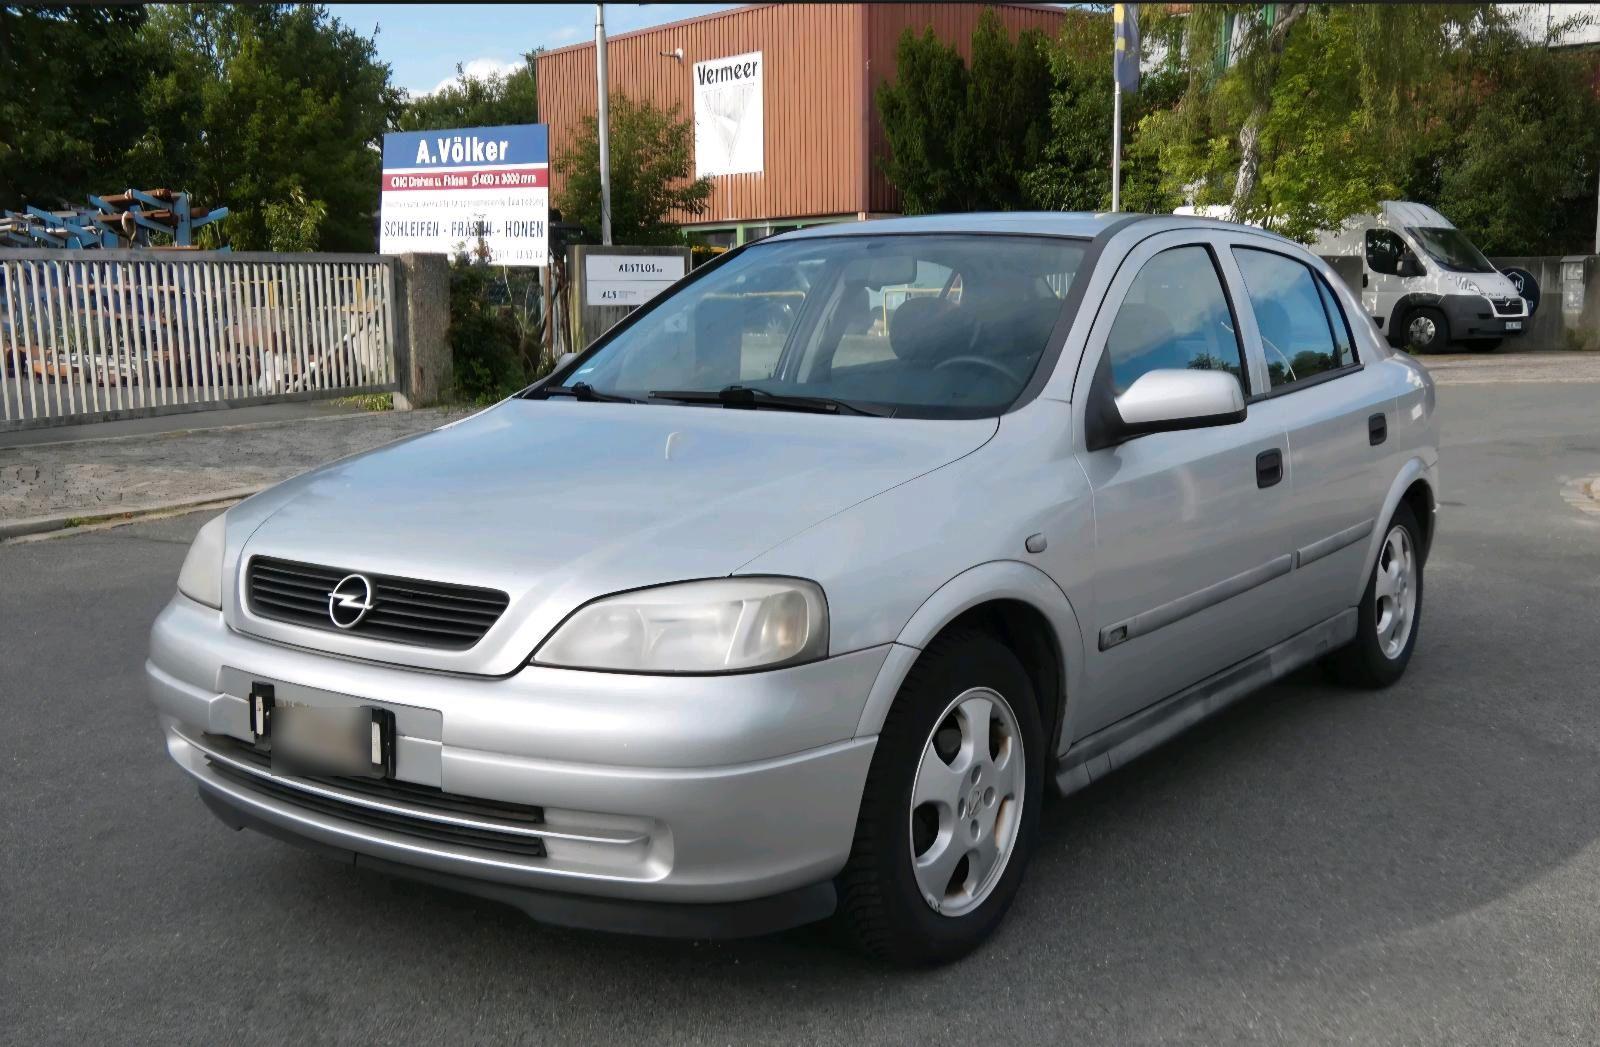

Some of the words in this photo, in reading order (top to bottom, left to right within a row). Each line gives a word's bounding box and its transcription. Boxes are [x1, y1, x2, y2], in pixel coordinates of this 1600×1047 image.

[697, 61, 758, 86] Vermeer
[384, 220, 439, 237] SCHLEIFEN
[505, 220, 544, 237] HONEN
